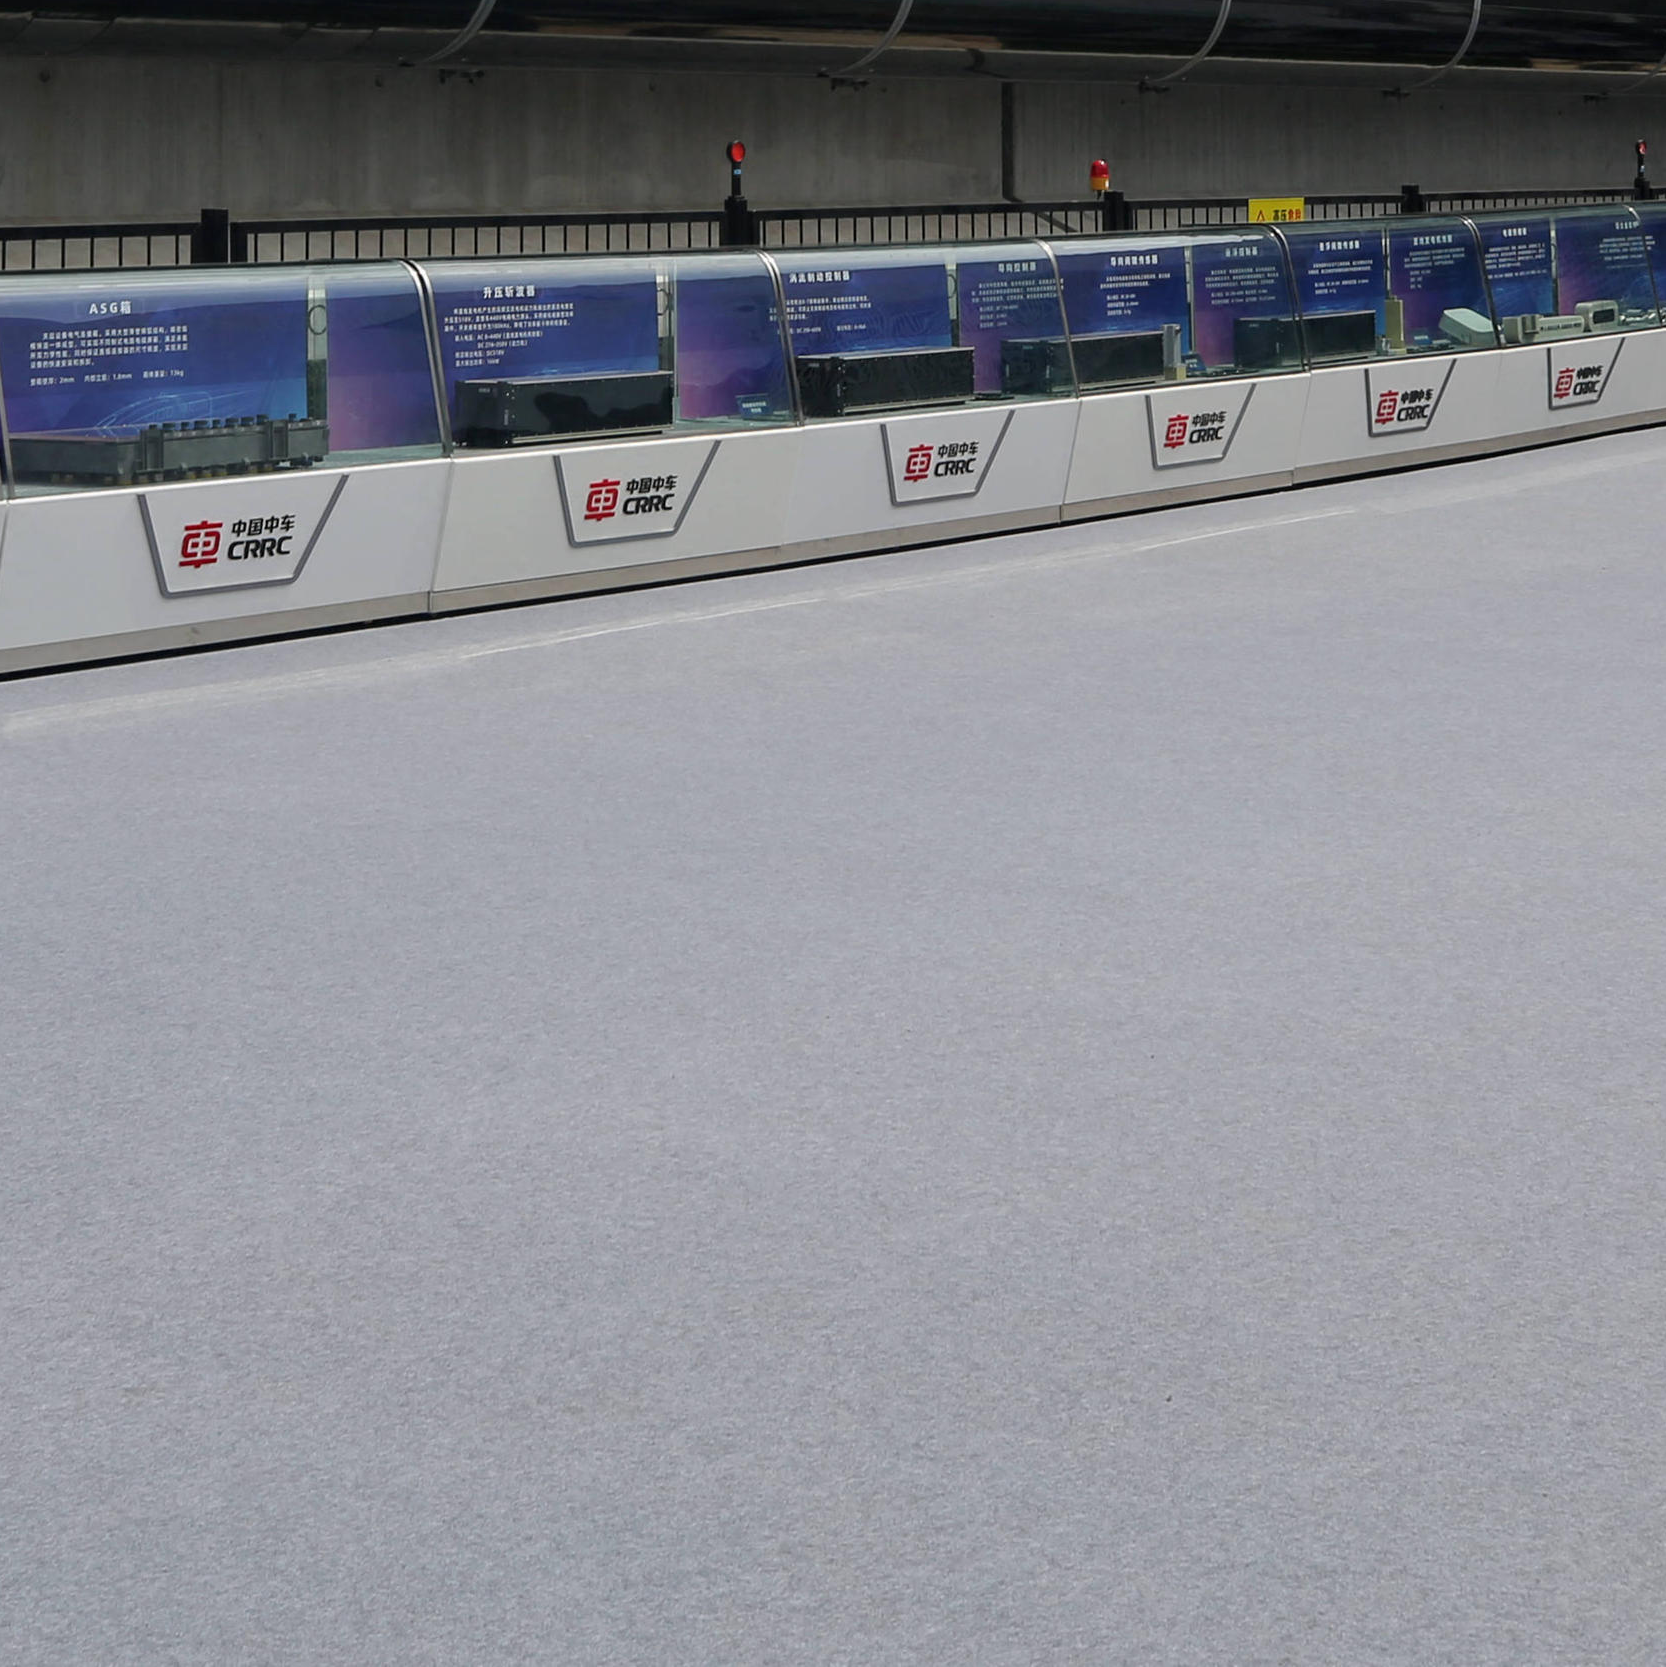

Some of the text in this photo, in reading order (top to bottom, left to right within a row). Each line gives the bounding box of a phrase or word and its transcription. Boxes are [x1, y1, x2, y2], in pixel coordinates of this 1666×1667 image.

[483, 285, 535, 299] 升压斩波器
[89, 301, 132, 315] ASG箱
[1191, 410, 1227, 428] 中国中车
[1188, 426, 1226, 446] CRRC
[937, 441, 979, 459] 中国中车
[934, 458, 977, 478] CRRC
[626, 475, 677, 495] 中国中车
[623, 493, 675, 516] CRRC
[231, 514, 296, 538] 中国中车
[228, 536, 293, 561] CRRC
